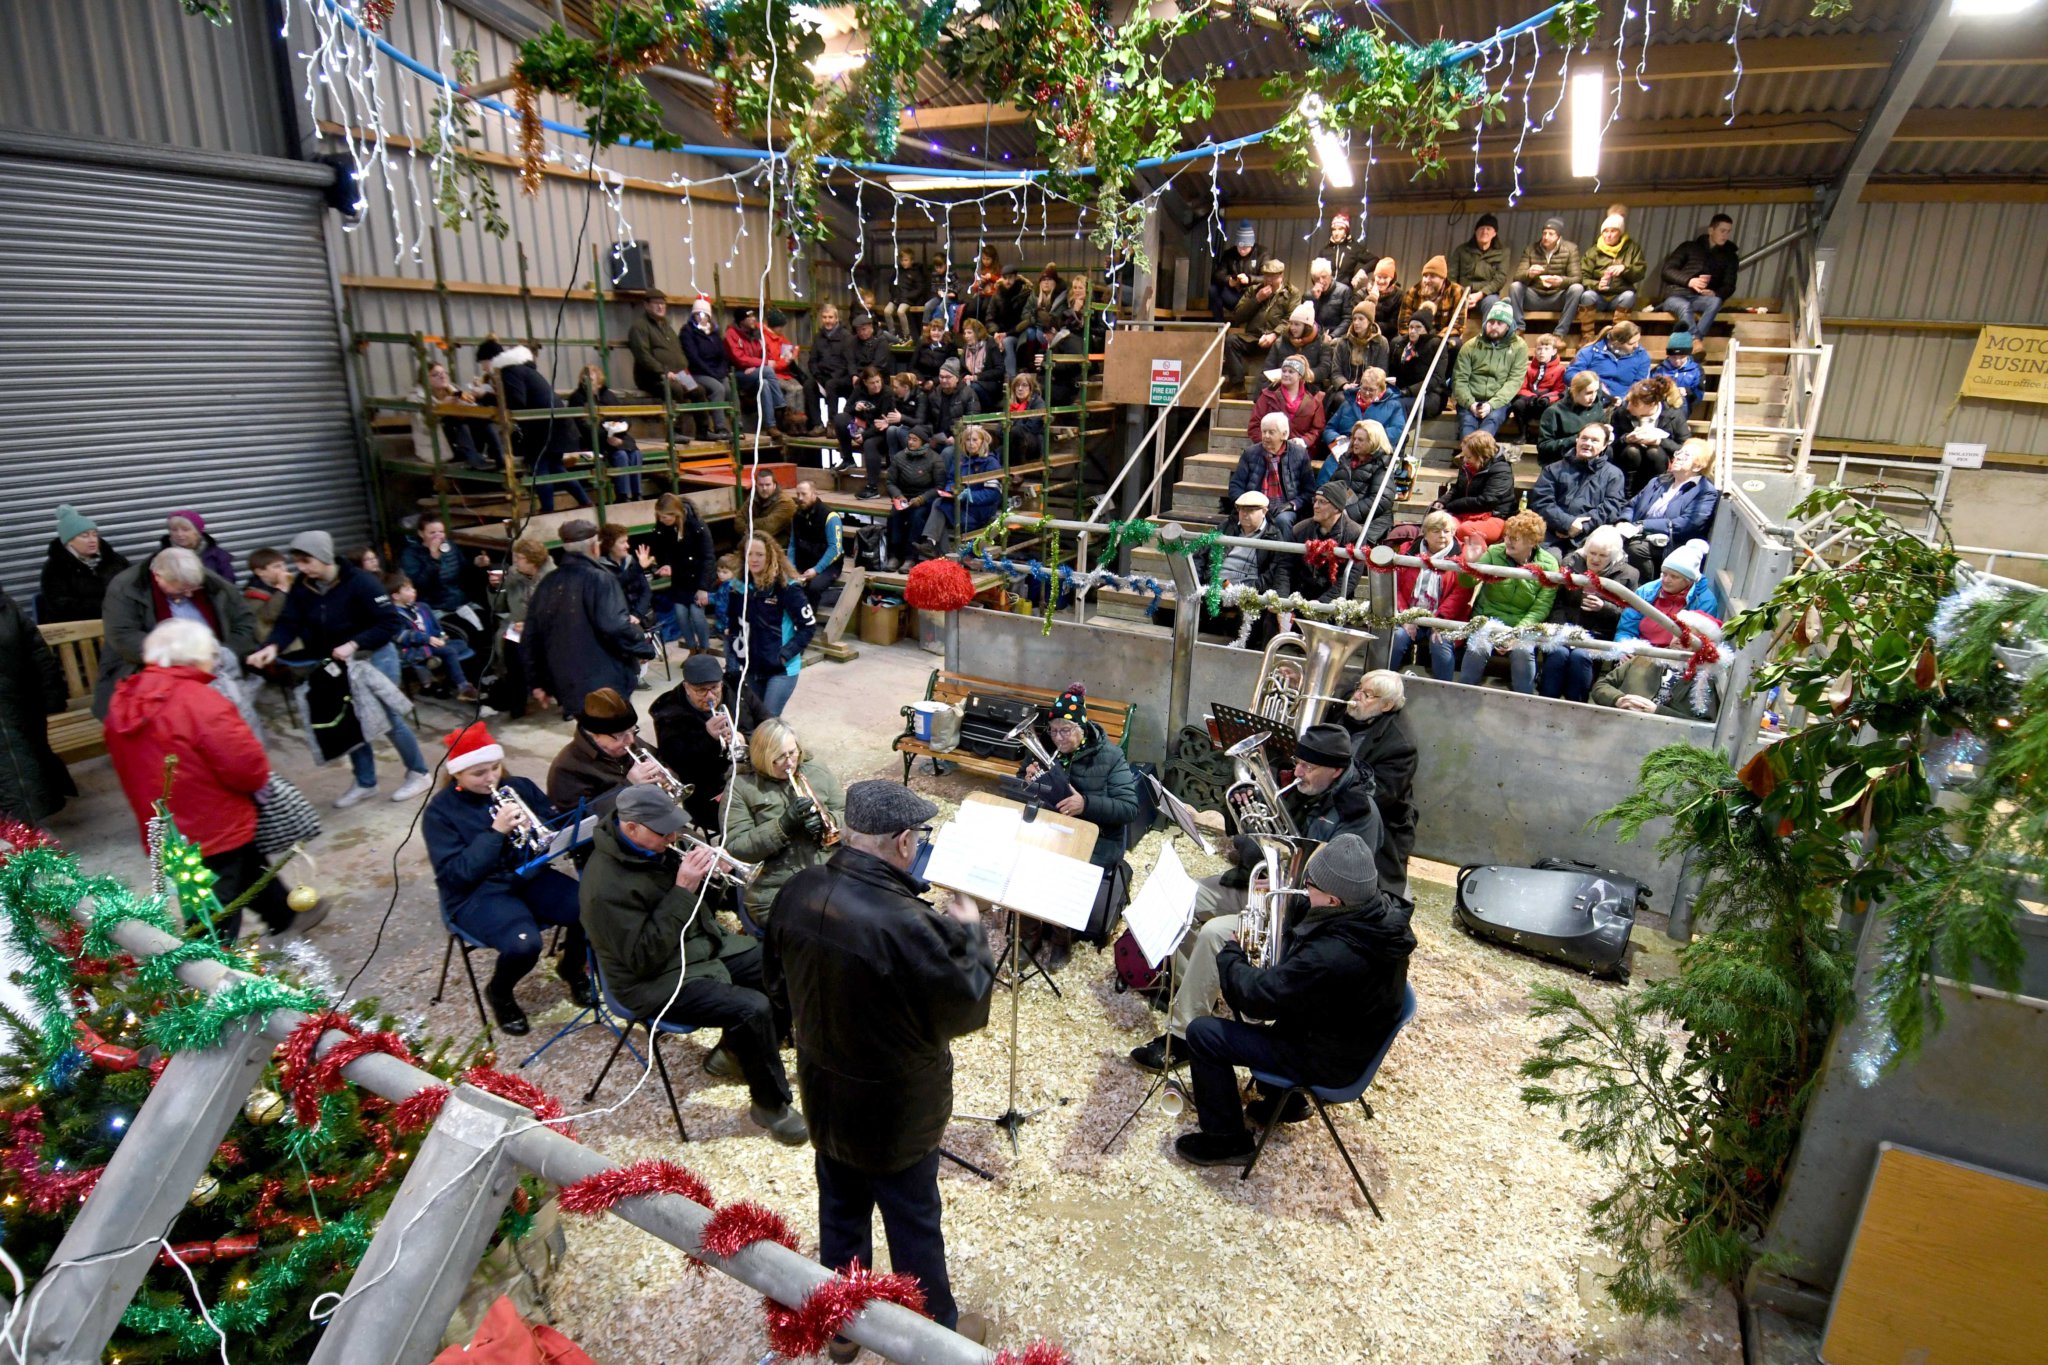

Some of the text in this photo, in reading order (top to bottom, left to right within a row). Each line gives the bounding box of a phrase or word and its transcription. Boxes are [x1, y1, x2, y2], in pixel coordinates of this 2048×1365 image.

[1979, 355, 2048, 374] BUSIN
[1973, 376, 1993, 384] Call
[2013, 378, 2040, 388] office
